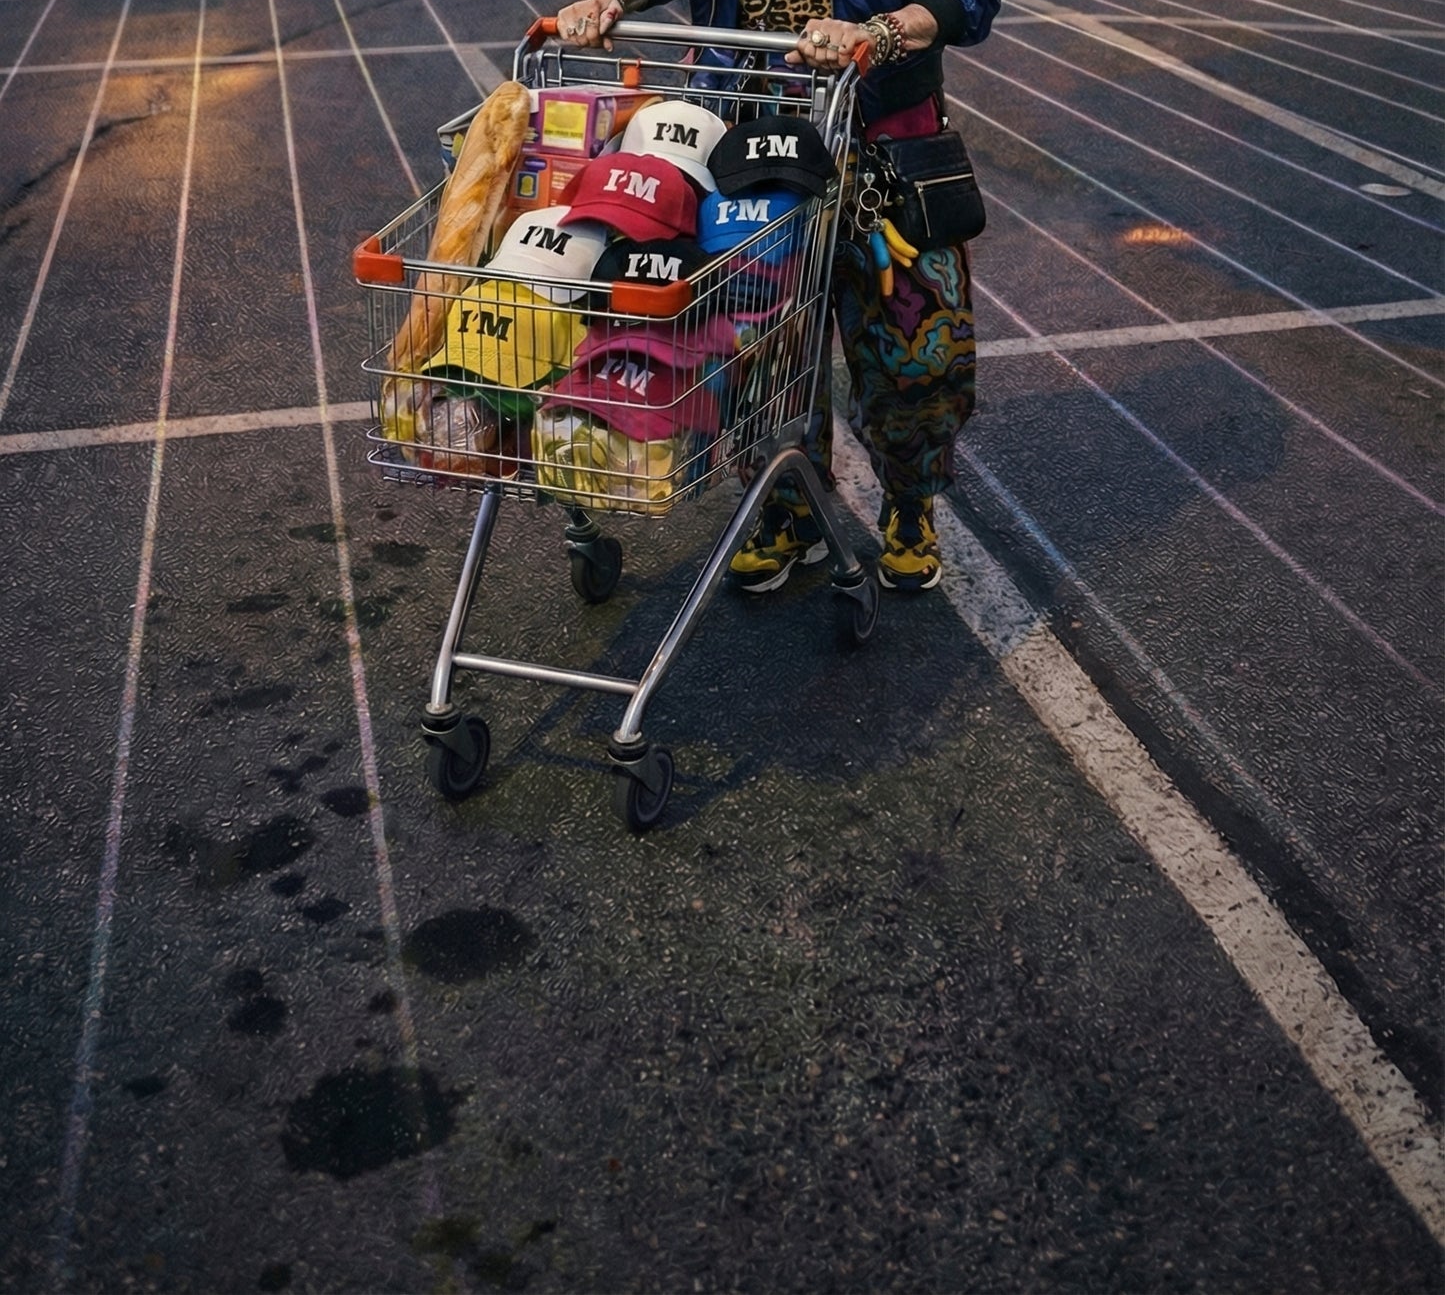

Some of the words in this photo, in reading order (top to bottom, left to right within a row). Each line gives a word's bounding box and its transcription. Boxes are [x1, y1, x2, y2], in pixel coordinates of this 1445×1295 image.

[653, 122, 699, 149] I'M
[746, 134, 799, 160] I'M
[603, 168, 661, 204] I'M
[715, 198, 771, 225] I'M
[519, 225, 573, 256] I'M
[624, 253, 683, 281] I'M
[457, 310, 513, 343] I'M
[595, 358, 655, 396] I'M
